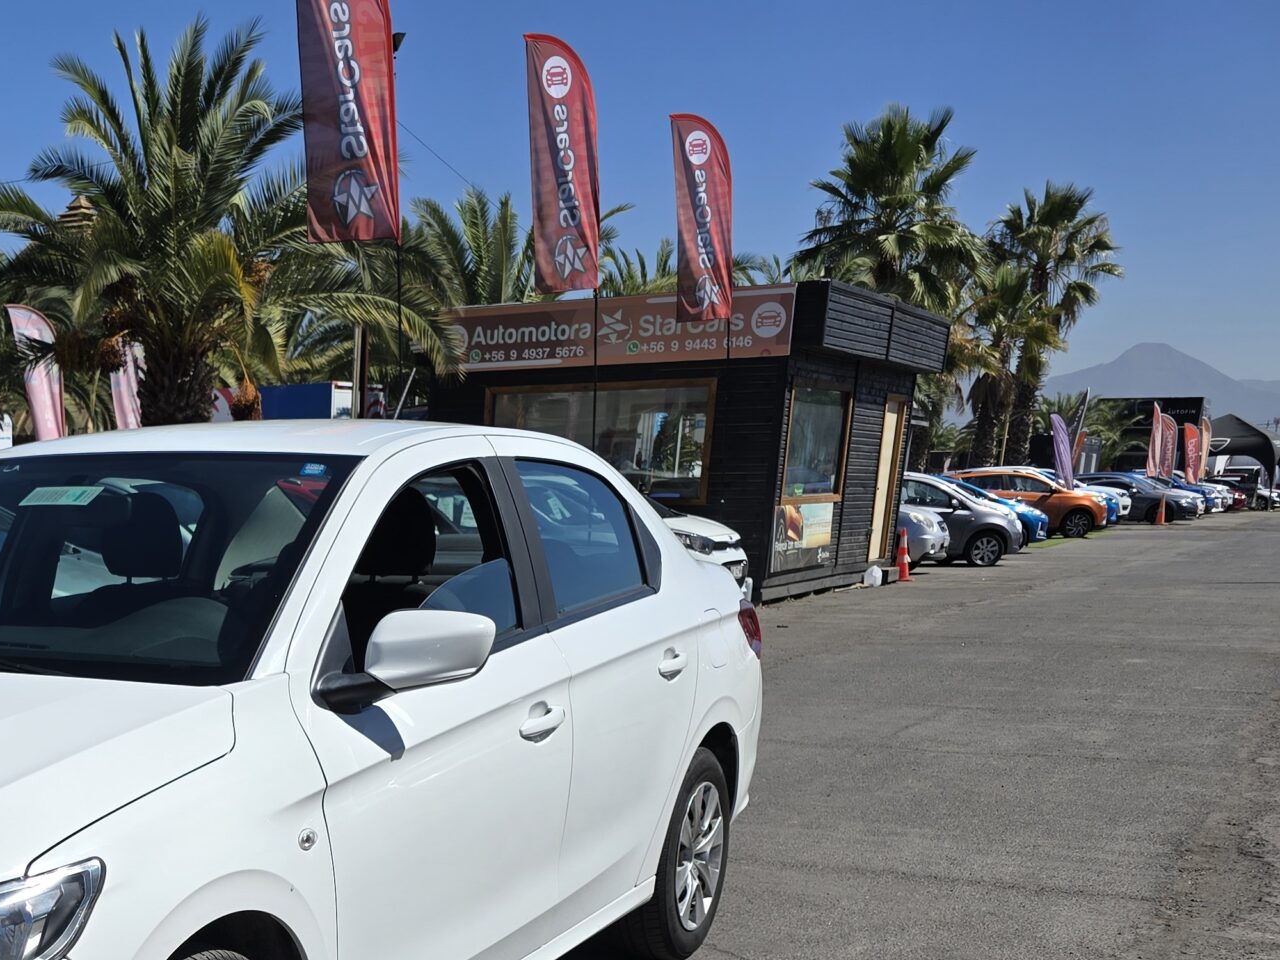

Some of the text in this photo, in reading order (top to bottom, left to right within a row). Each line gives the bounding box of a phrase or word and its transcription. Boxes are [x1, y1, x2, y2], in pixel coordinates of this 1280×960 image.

[471, 321, 592, 346] Automotora
[641, 336, 753, 353] +56 9 9443 6146
[484, 346, 584, 362] +56 9 4937 5676
